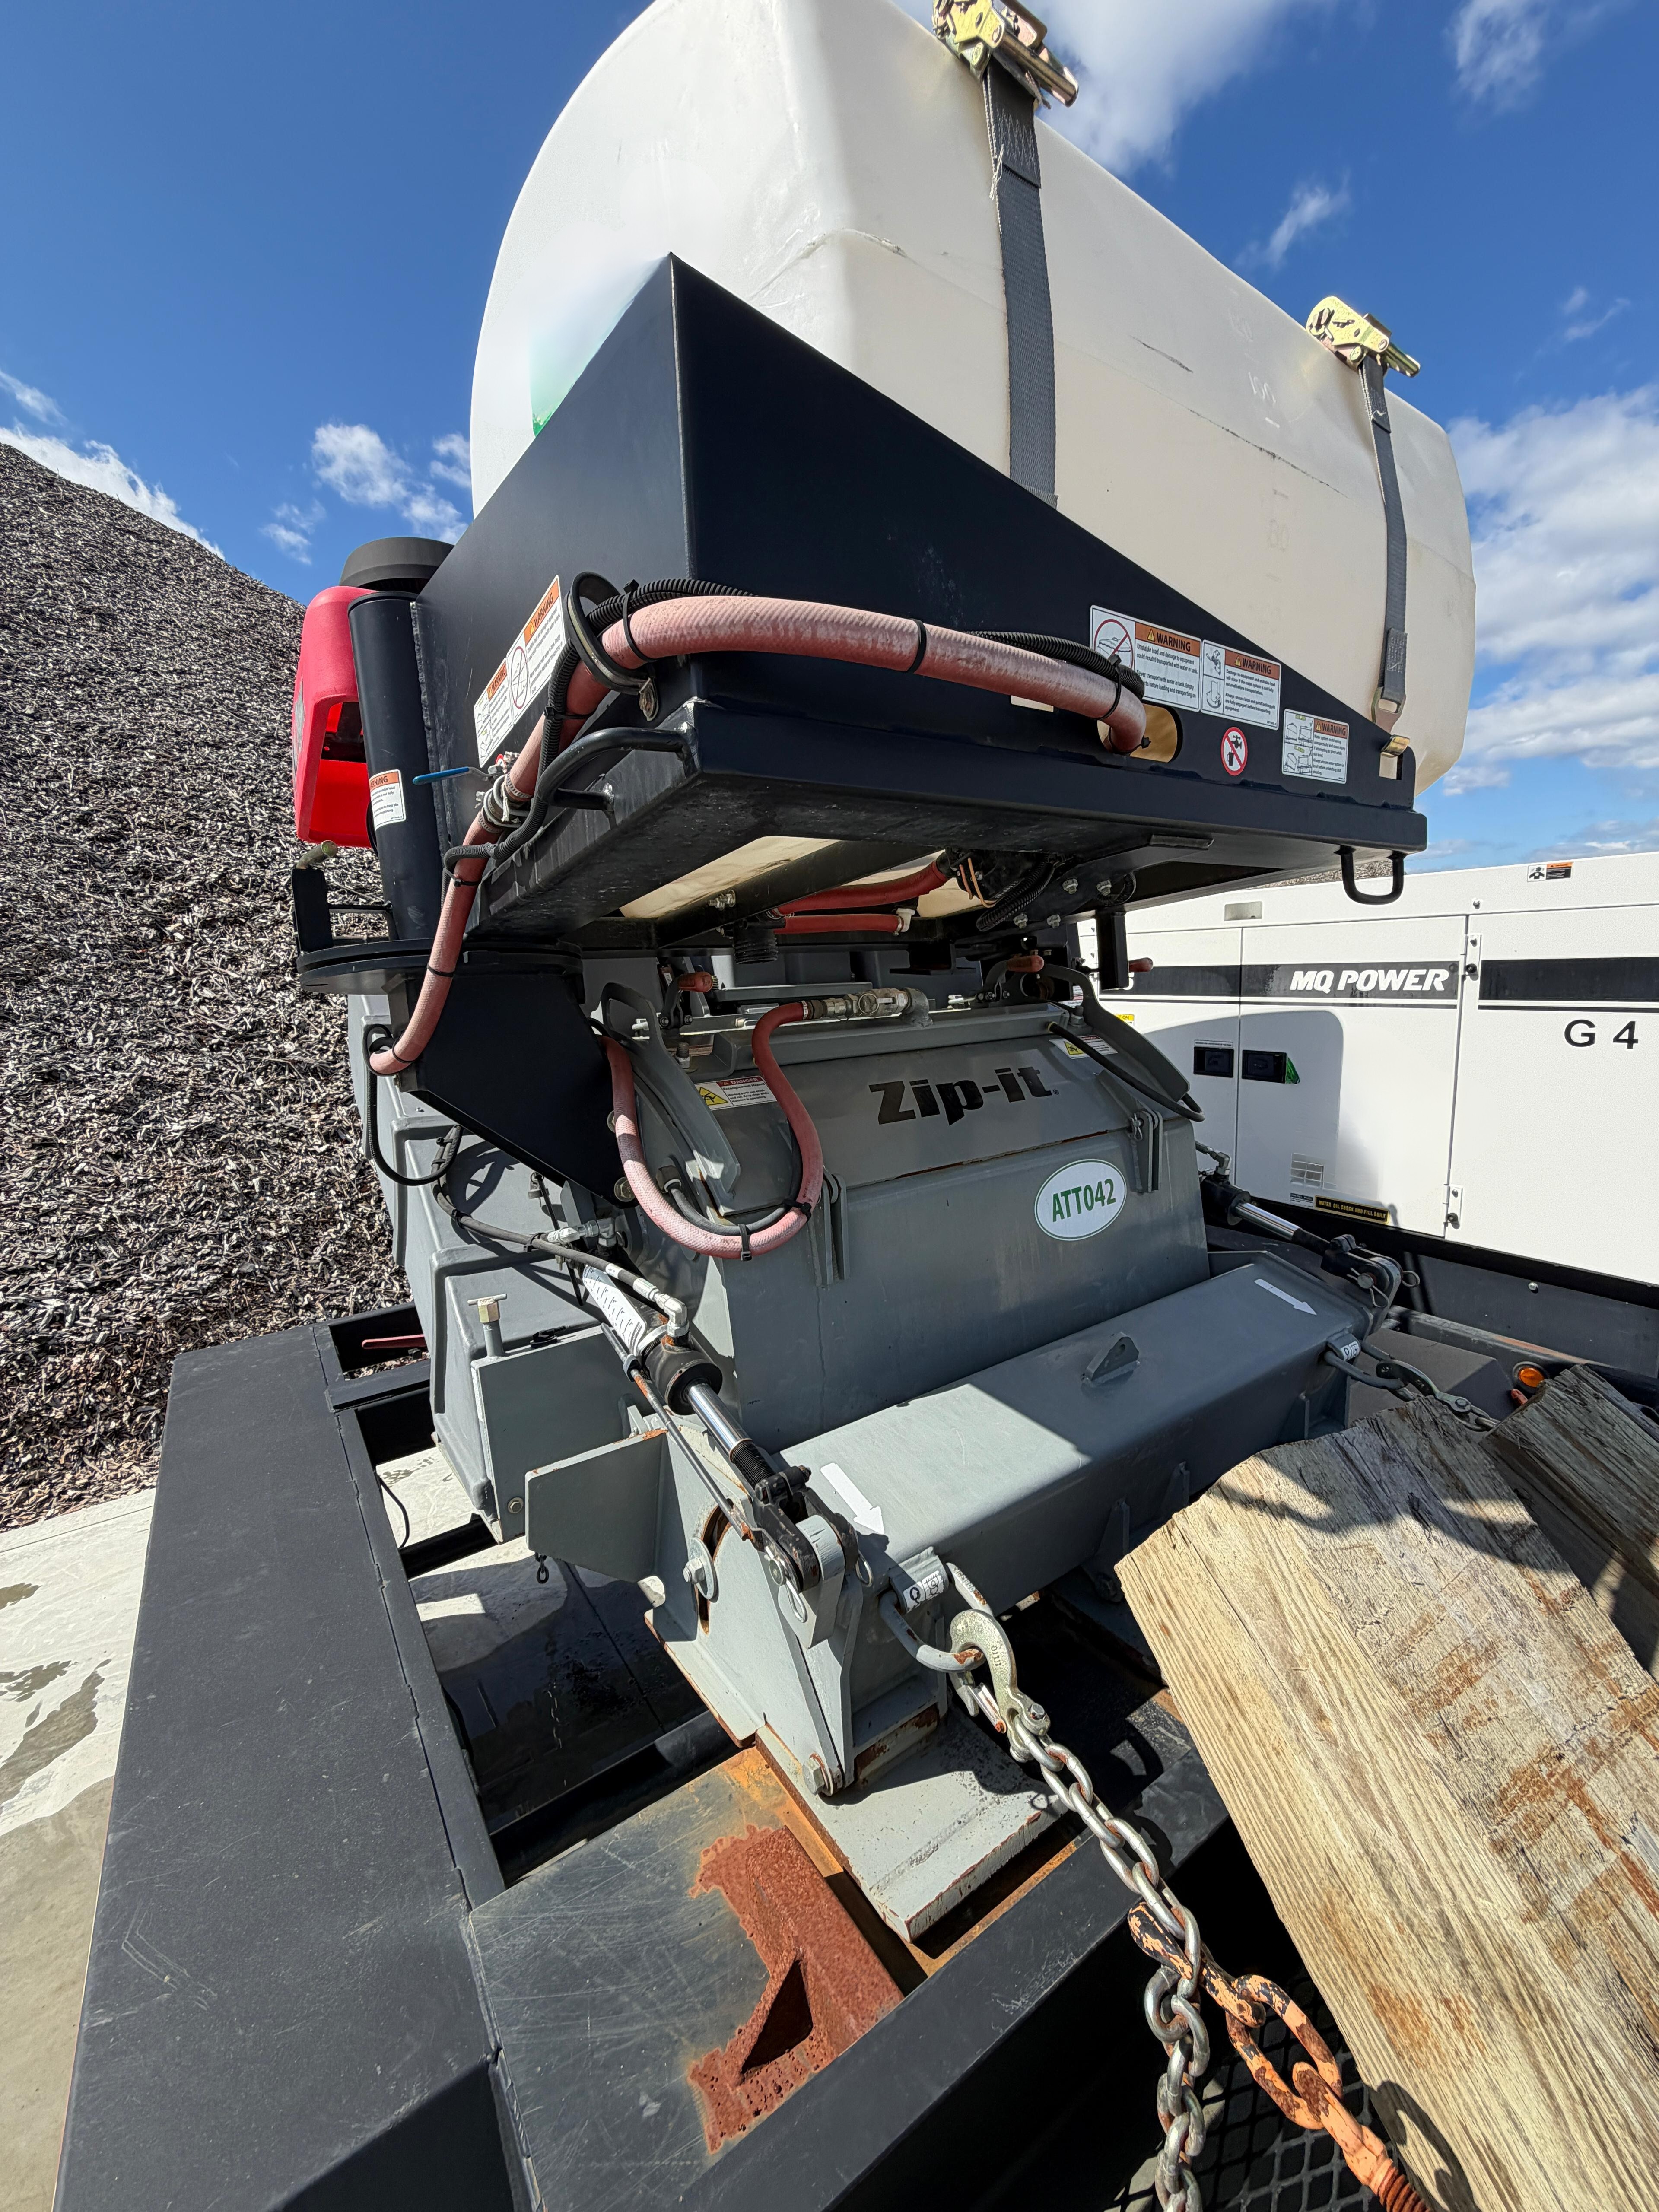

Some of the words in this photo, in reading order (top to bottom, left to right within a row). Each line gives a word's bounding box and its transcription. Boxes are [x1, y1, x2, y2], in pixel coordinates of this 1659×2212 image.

[534, 592, 553, 627] WARNING
[1157, 632, 1191, 652] WARNING
[1242, 658, 1271, 674] WARNING
[1322, 723, 1346, 736] WARNING
[370, 776, 388, 787] ARNING
[1290, 970, 1334, 994] MQ
[1337, 969, 1449, 991] POWER
[1564, 1019, 1596, 1047] G
[1613, 1021, 1638, 1049] 4
[1052, 1179, 1116, 1222] ATT042
